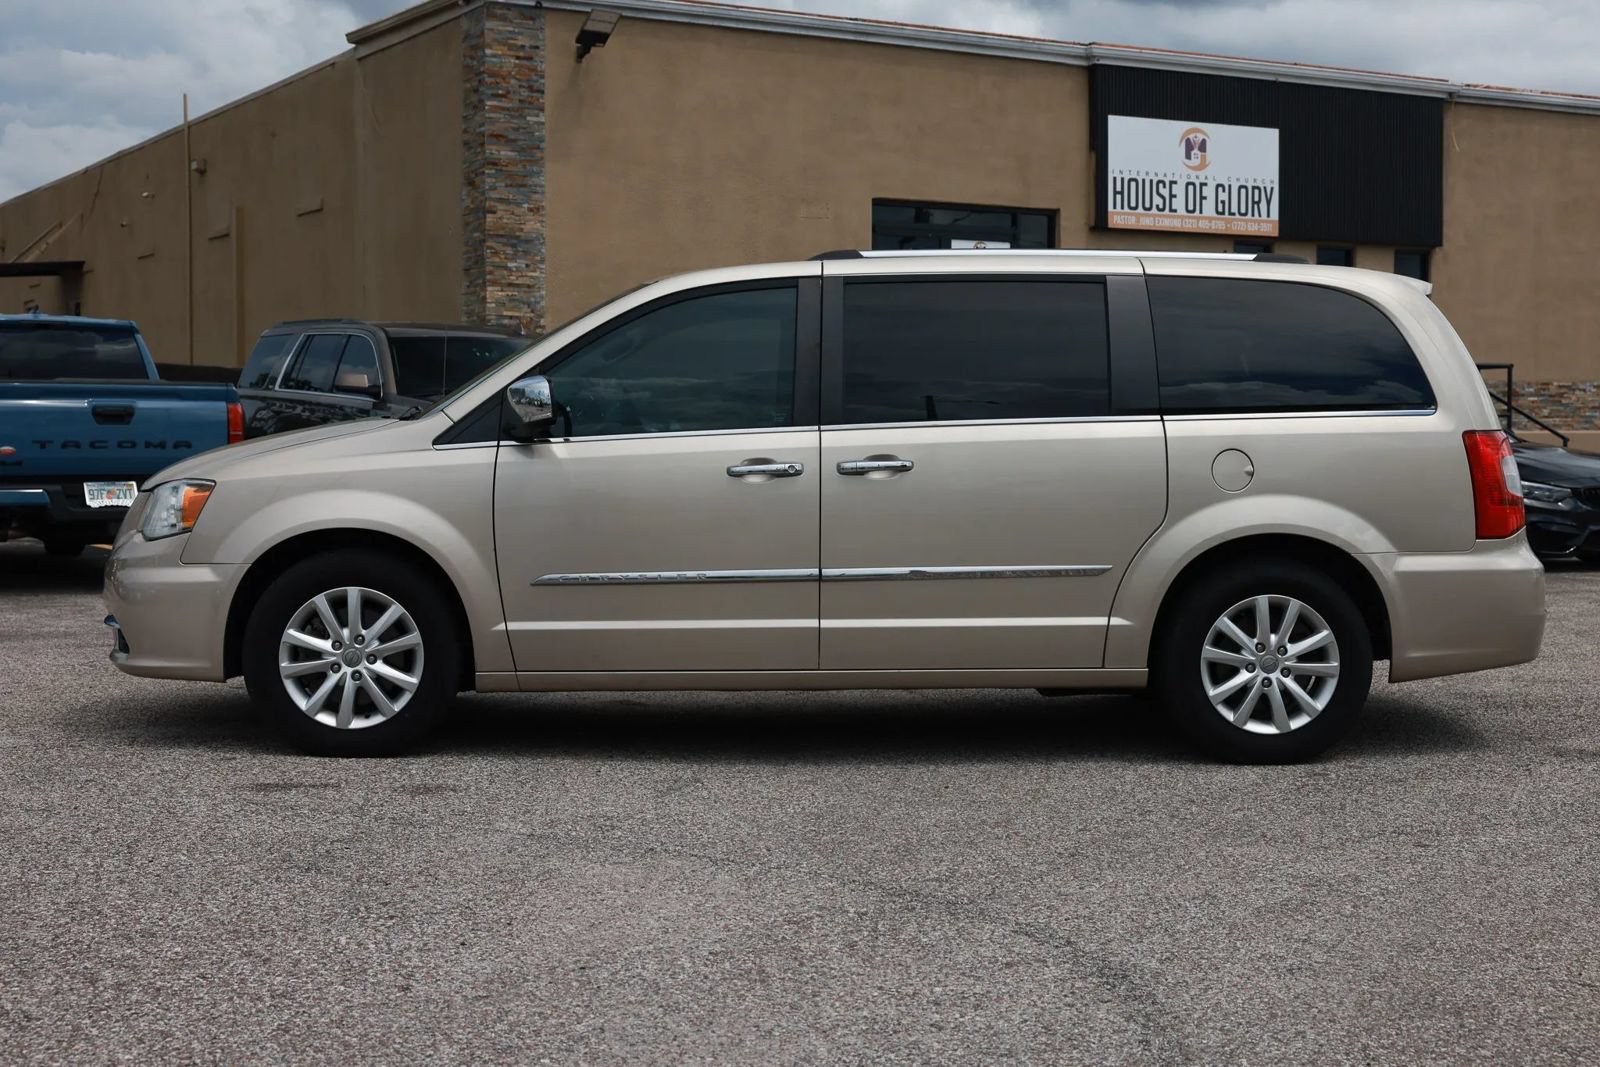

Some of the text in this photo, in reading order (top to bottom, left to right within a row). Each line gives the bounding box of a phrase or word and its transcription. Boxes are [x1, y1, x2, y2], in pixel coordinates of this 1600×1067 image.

[1112, 169, 1275, 185] INTERNATIONAL CHURCH
[1113, 176, 1274, 218] HOUSE OF GLORY
[32, 440, 192, 449] TACOMA
[559, 573, 707, 582] CHRYSLER
